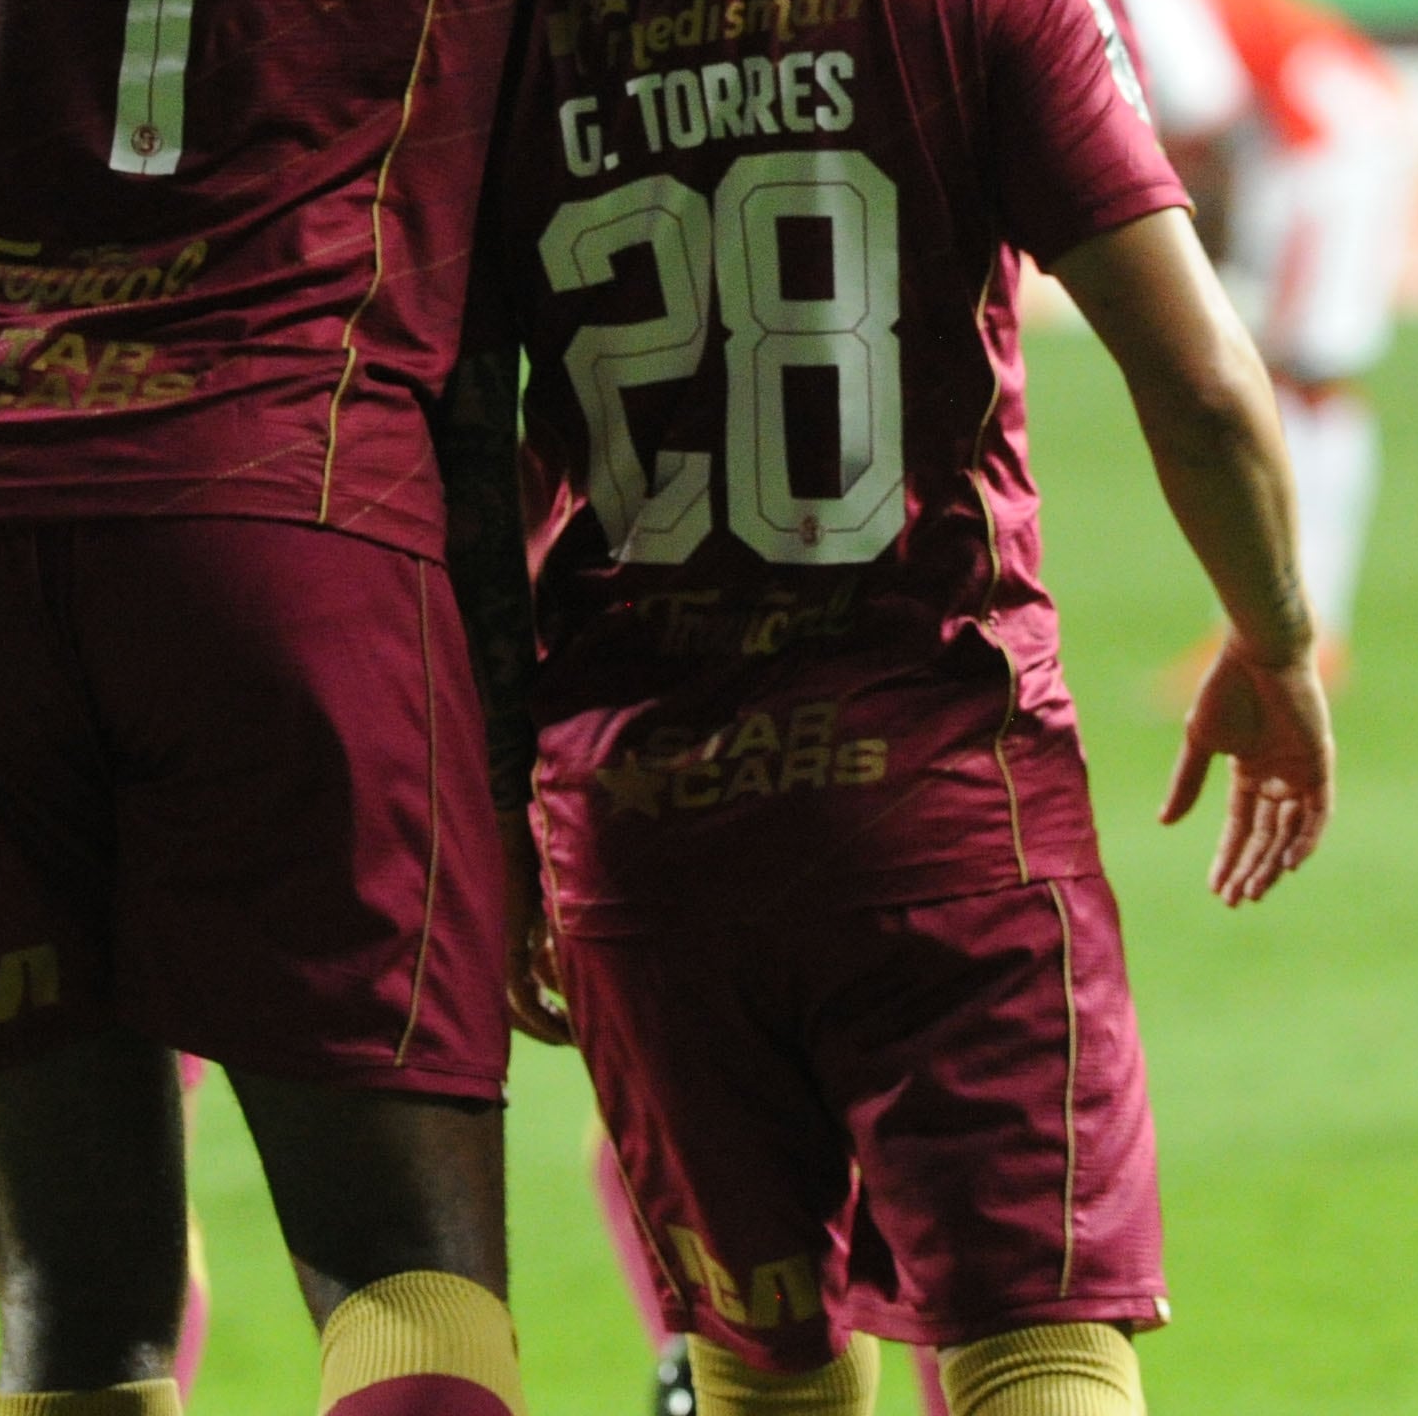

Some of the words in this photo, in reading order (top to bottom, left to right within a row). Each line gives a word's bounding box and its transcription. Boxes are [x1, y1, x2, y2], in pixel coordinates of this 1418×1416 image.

[559, 96, 619, 177] G.
[626, 50, 855, 154] TORRES
[538, 150, 906, 565] 28
